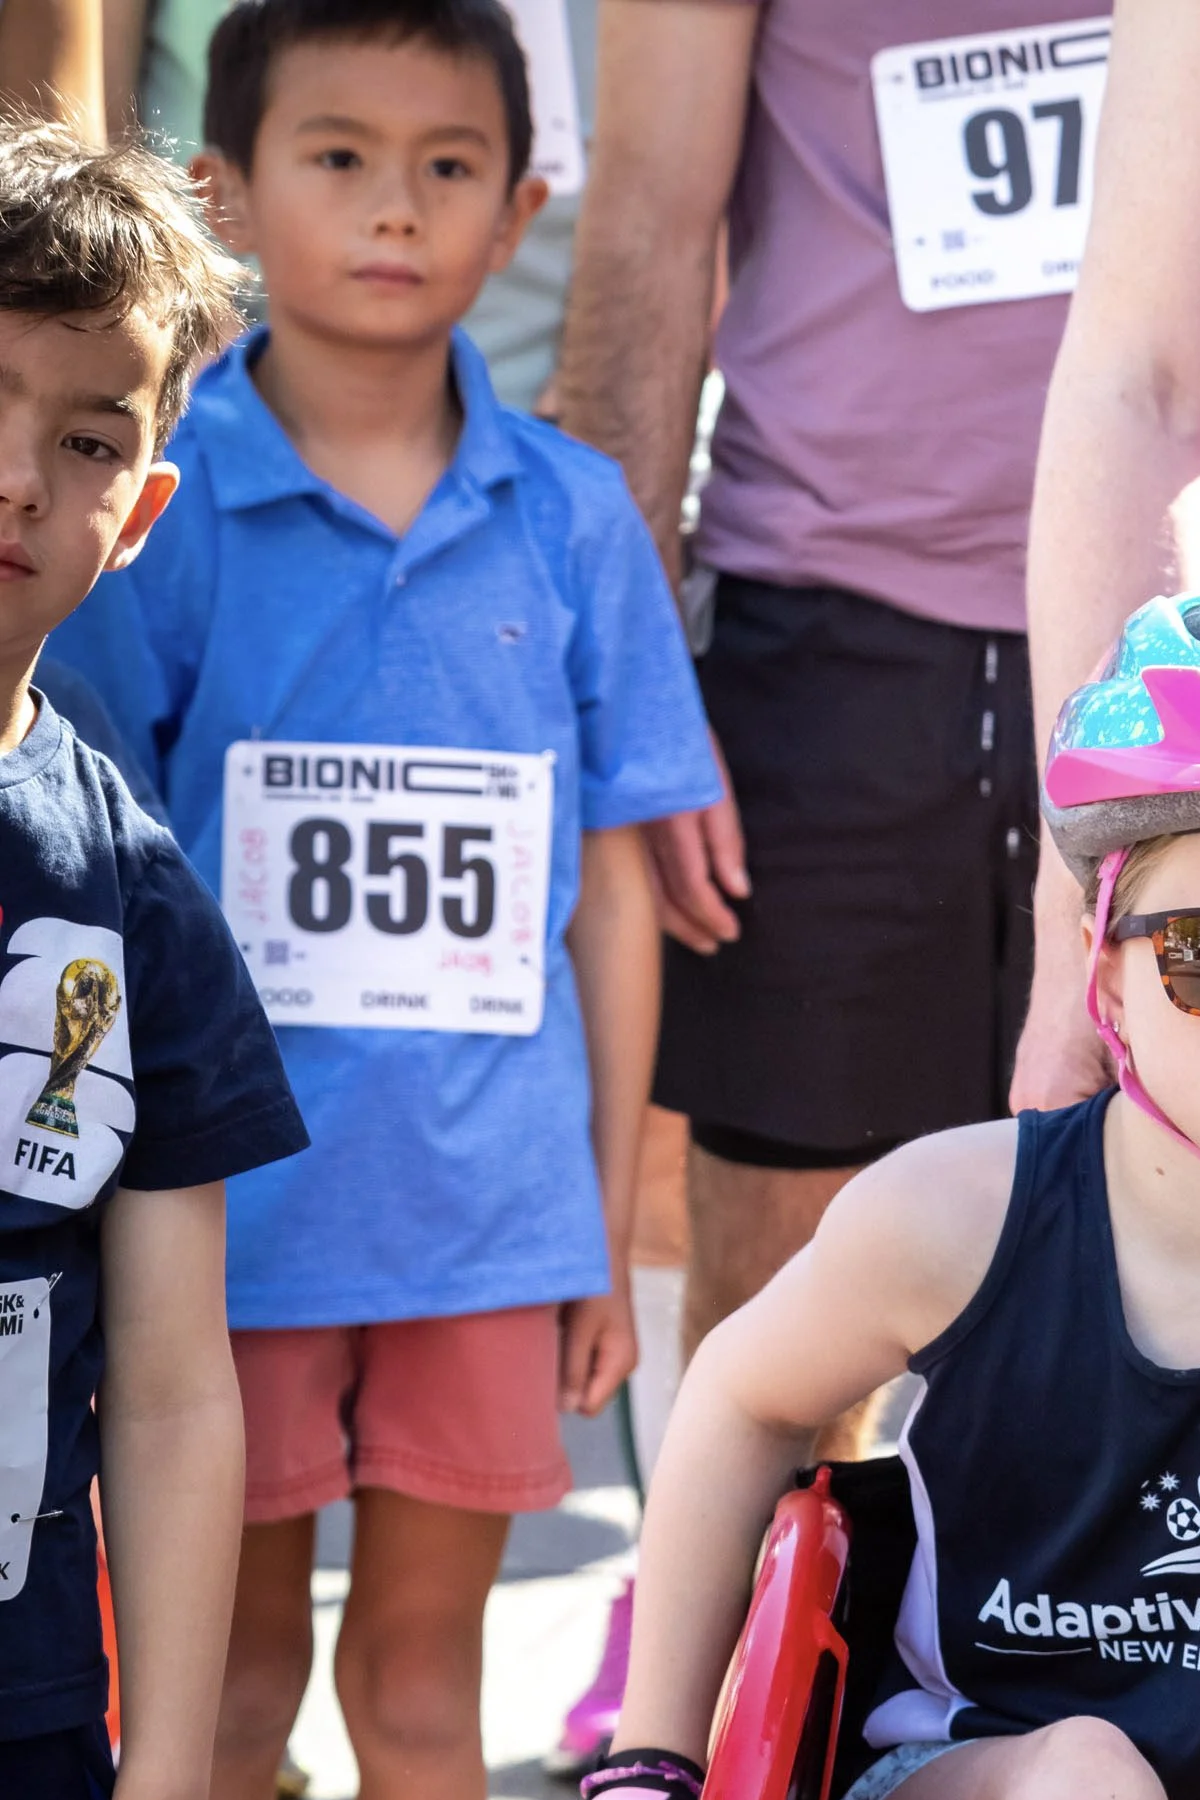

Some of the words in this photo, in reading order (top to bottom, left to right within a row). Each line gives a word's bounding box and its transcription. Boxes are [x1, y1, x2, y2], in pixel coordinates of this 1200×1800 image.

[914, 30, 1111, 89] BIONIC
[964, 96, 1083, 216] 97
[263, 755, 483, 796] BIONIC
[286, 816, 497, 939] 855
[13, 1138, 77, 1181] FIFA
[0, 1293, 24, 1314] K&
[1100, 1641, 1175, 1664] NEW
